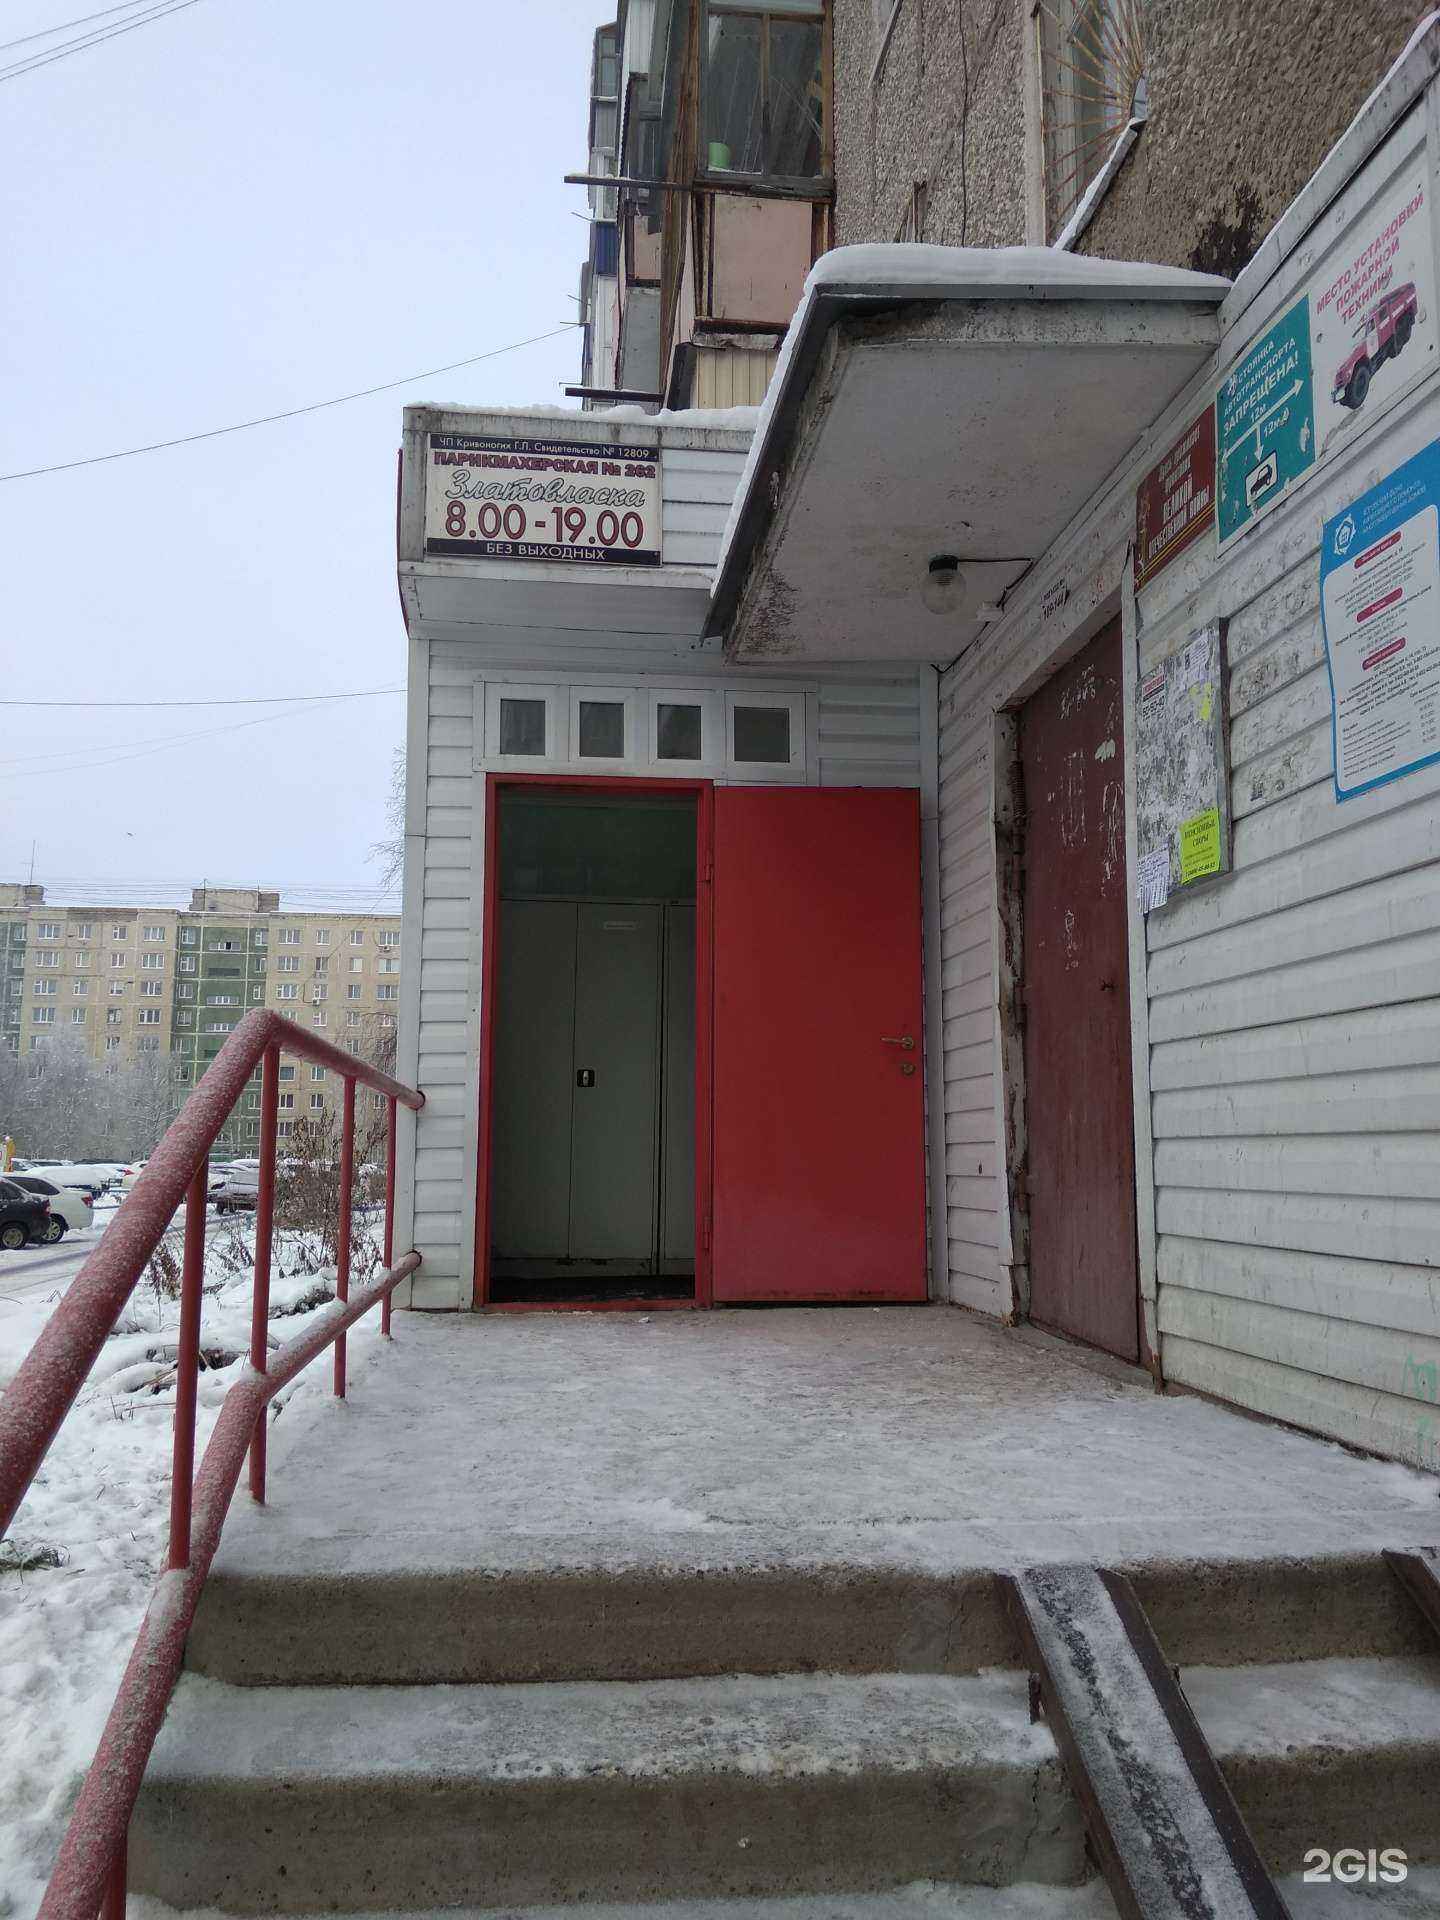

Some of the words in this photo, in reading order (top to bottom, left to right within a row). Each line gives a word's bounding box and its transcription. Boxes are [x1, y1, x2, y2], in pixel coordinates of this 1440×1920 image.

[1316, 270, 1351, 314] МЕСТО
[1353, 192, 1424, 276] УСТАНОВКИ
[1336, 237, 1400, 312] ПОЖАРНОЙ
[1224, 337, 1296, 417] АВТОТРАНСПОРТА
[1238, 341, 1274, 383] СТОЯНКА
[1223, 350, 1299, 437] ЗАПРЕЩЕНА!
[434, 451, 600, 475] ПАРИКМАХЕРСКАЯ
[602, 461, 621, 476] №
[440, 437, 453, 447] ЧП
[456, 437, 511, 450] Кривоногих
[534, 442, 600, 456] Свидетельство
[619, 447, 649, 458] 12809
[445, 469, 646, 507] Златовласка
[486, 542, 512, 555] БЕЗ
[518, 544, 606, 560] ВЫХОДНЫХ
